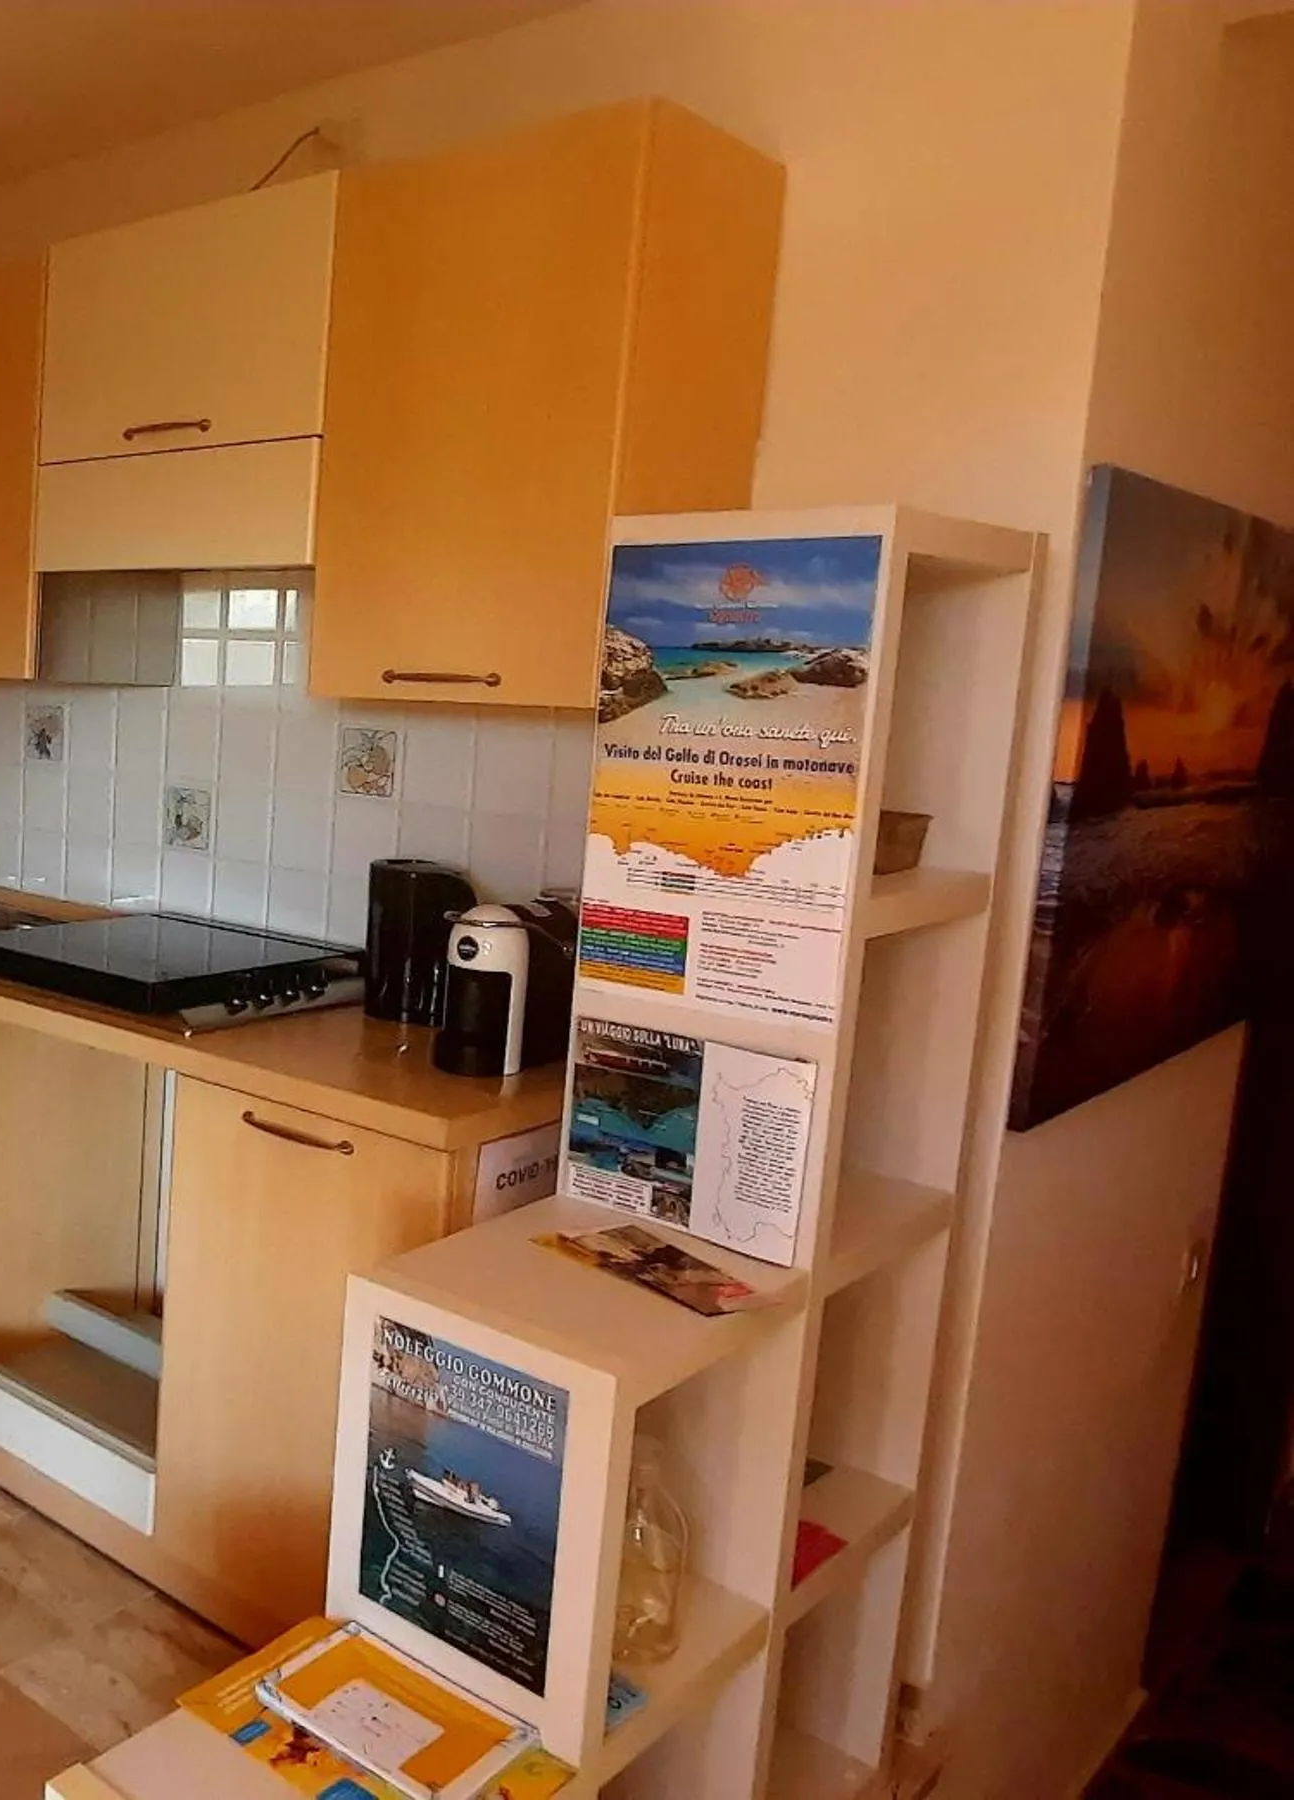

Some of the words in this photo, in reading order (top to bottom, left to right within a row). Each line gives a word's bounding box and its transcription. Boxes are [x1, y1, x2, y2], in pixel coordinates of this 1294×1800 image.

[643, 745, 662, 760] del
[703, 749, 716, 765] di
[719, 750, 762, 768] Orosei
[766, 753, 779, 770] in
[783, 757, 856, 775] motonave
[670, 769, 709, 786] Cruise
[713, 771, 734, 788] the
[738, 778, 773, 791] coast
[383, 1328, 464, 1375] NOLEGGIO
[468, 1364, 557, 1412] GOMMONE
